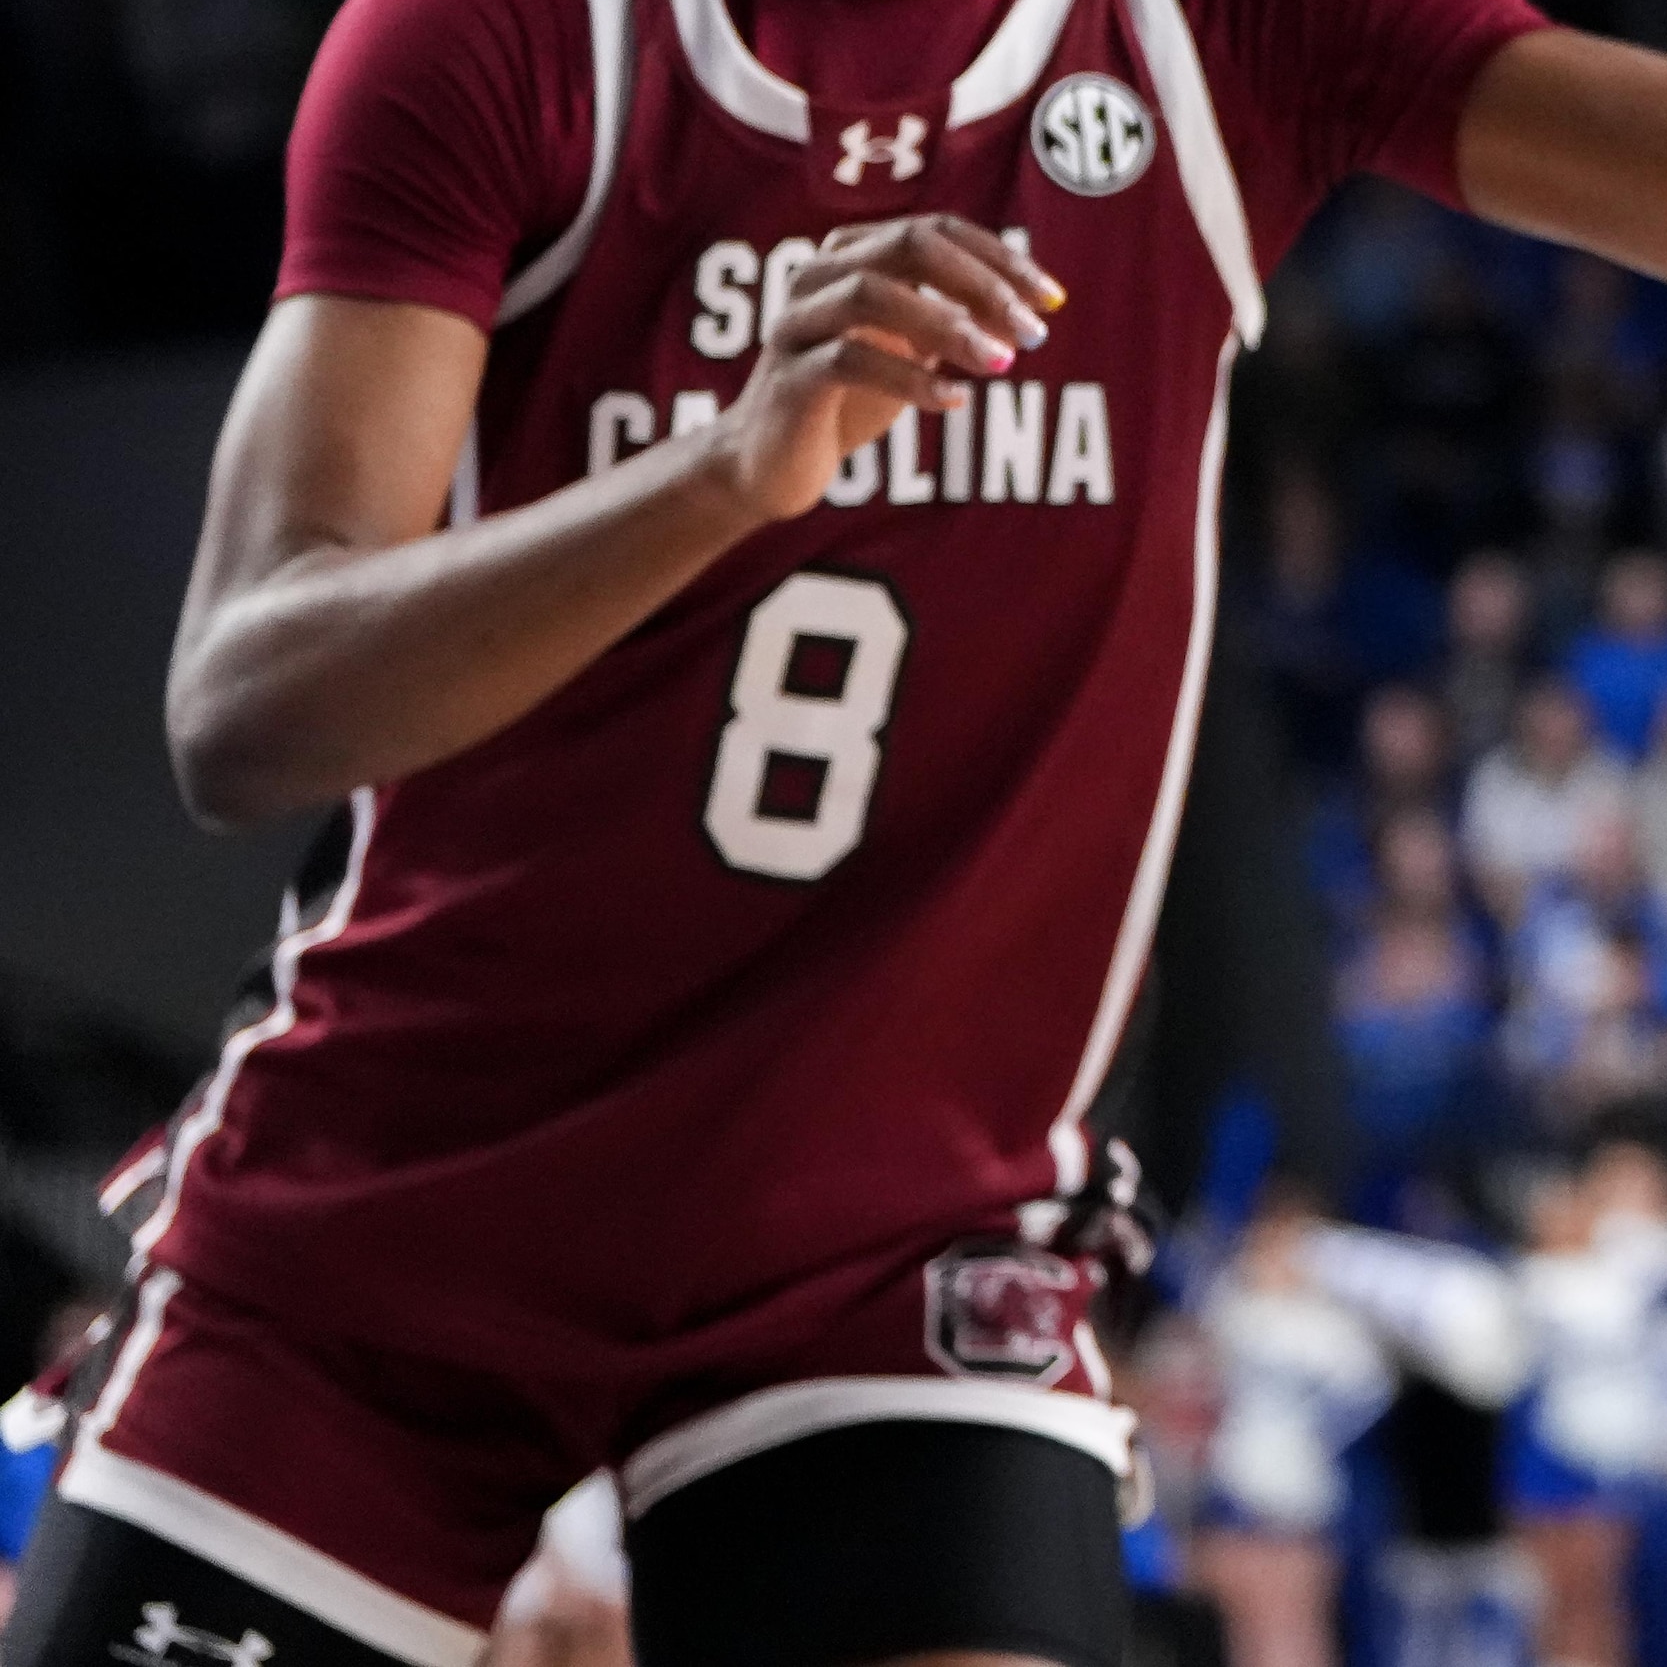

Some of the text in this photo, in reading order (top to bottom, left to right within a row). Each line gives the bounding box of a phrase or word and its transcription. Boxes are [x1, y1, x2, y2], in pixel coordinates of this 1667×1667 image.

[1040, 83, 1144, 185] SEC
[587, 380, 1116, 508] CLINA
[703, 570, 909, 881] 8
